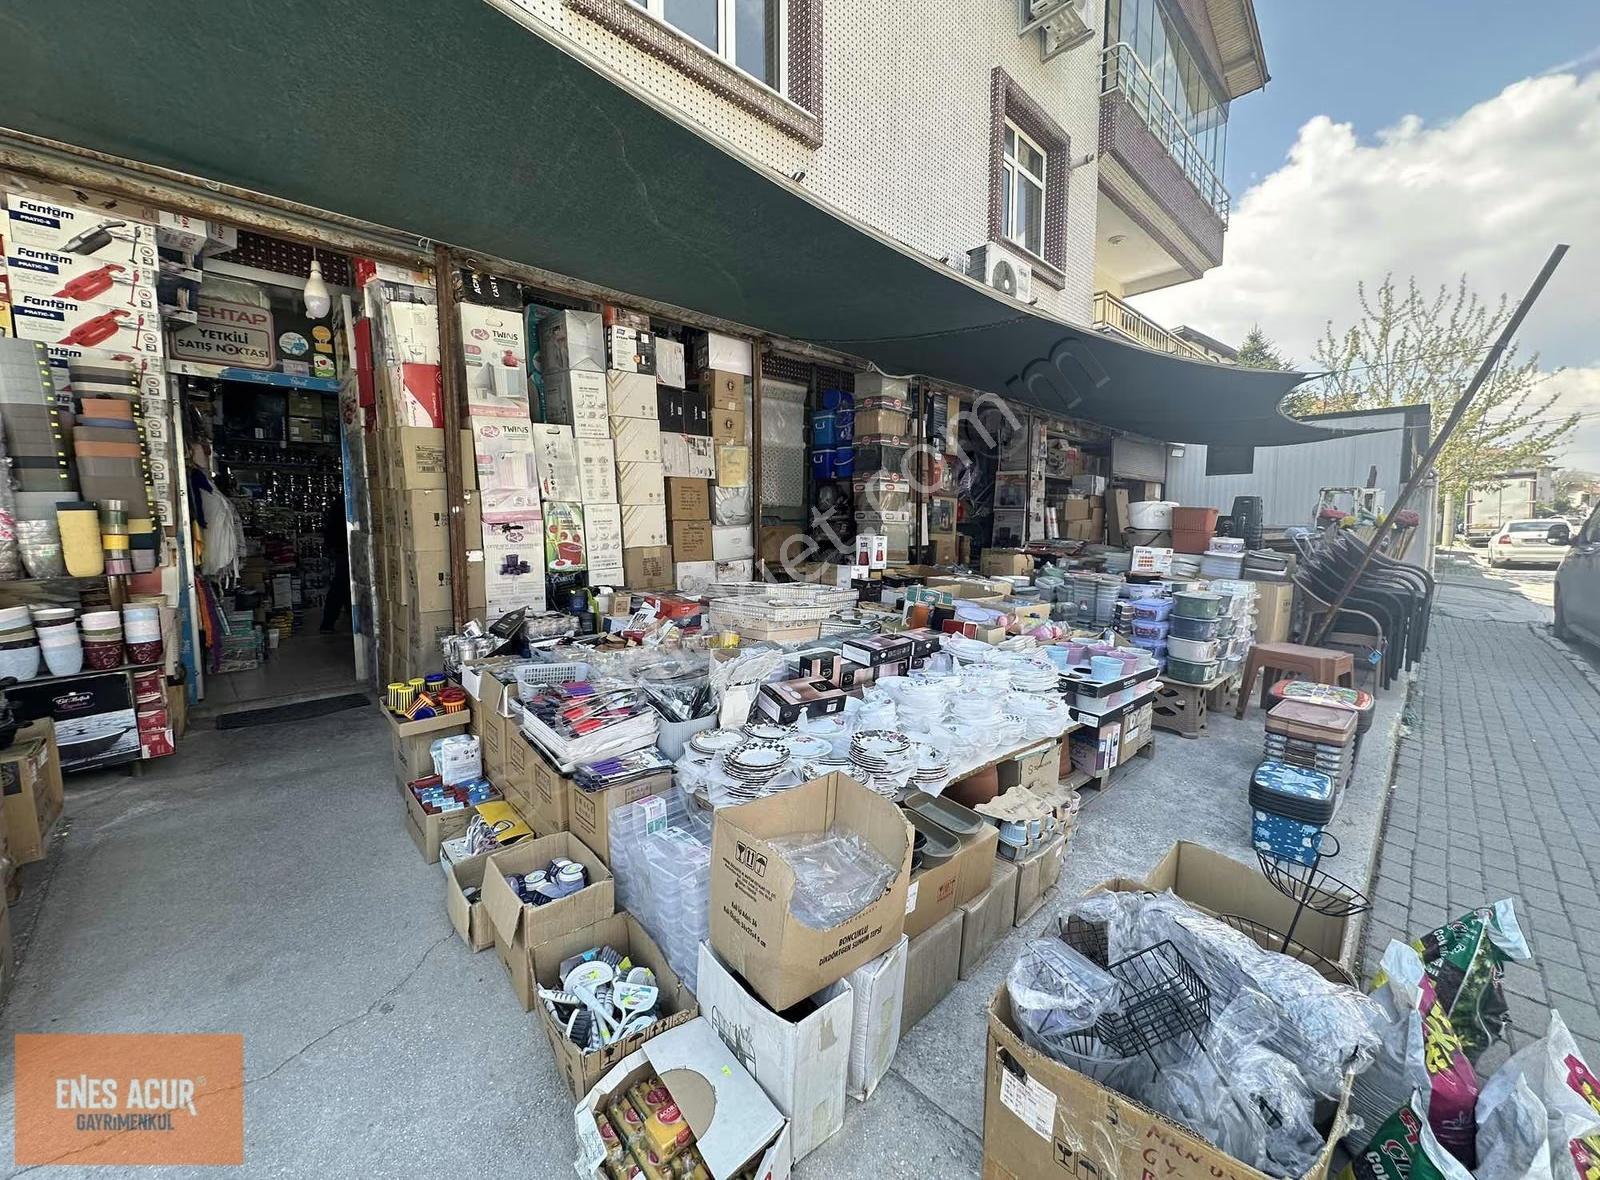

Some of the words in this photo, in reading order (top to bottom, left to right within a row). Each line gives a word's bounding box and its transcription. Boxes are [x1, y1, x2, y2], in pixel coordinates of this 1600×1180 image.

[199, 304, 267, 325] EHTAP
[199, 328, 249, 345] YETKİLİ
[492, 330, 519, 341] TWINS
[177, 339, 212, 352] SATIŞ
[216, 344, 269, 359] NOKTASI
[502, 425, 529, 434] TWINS
